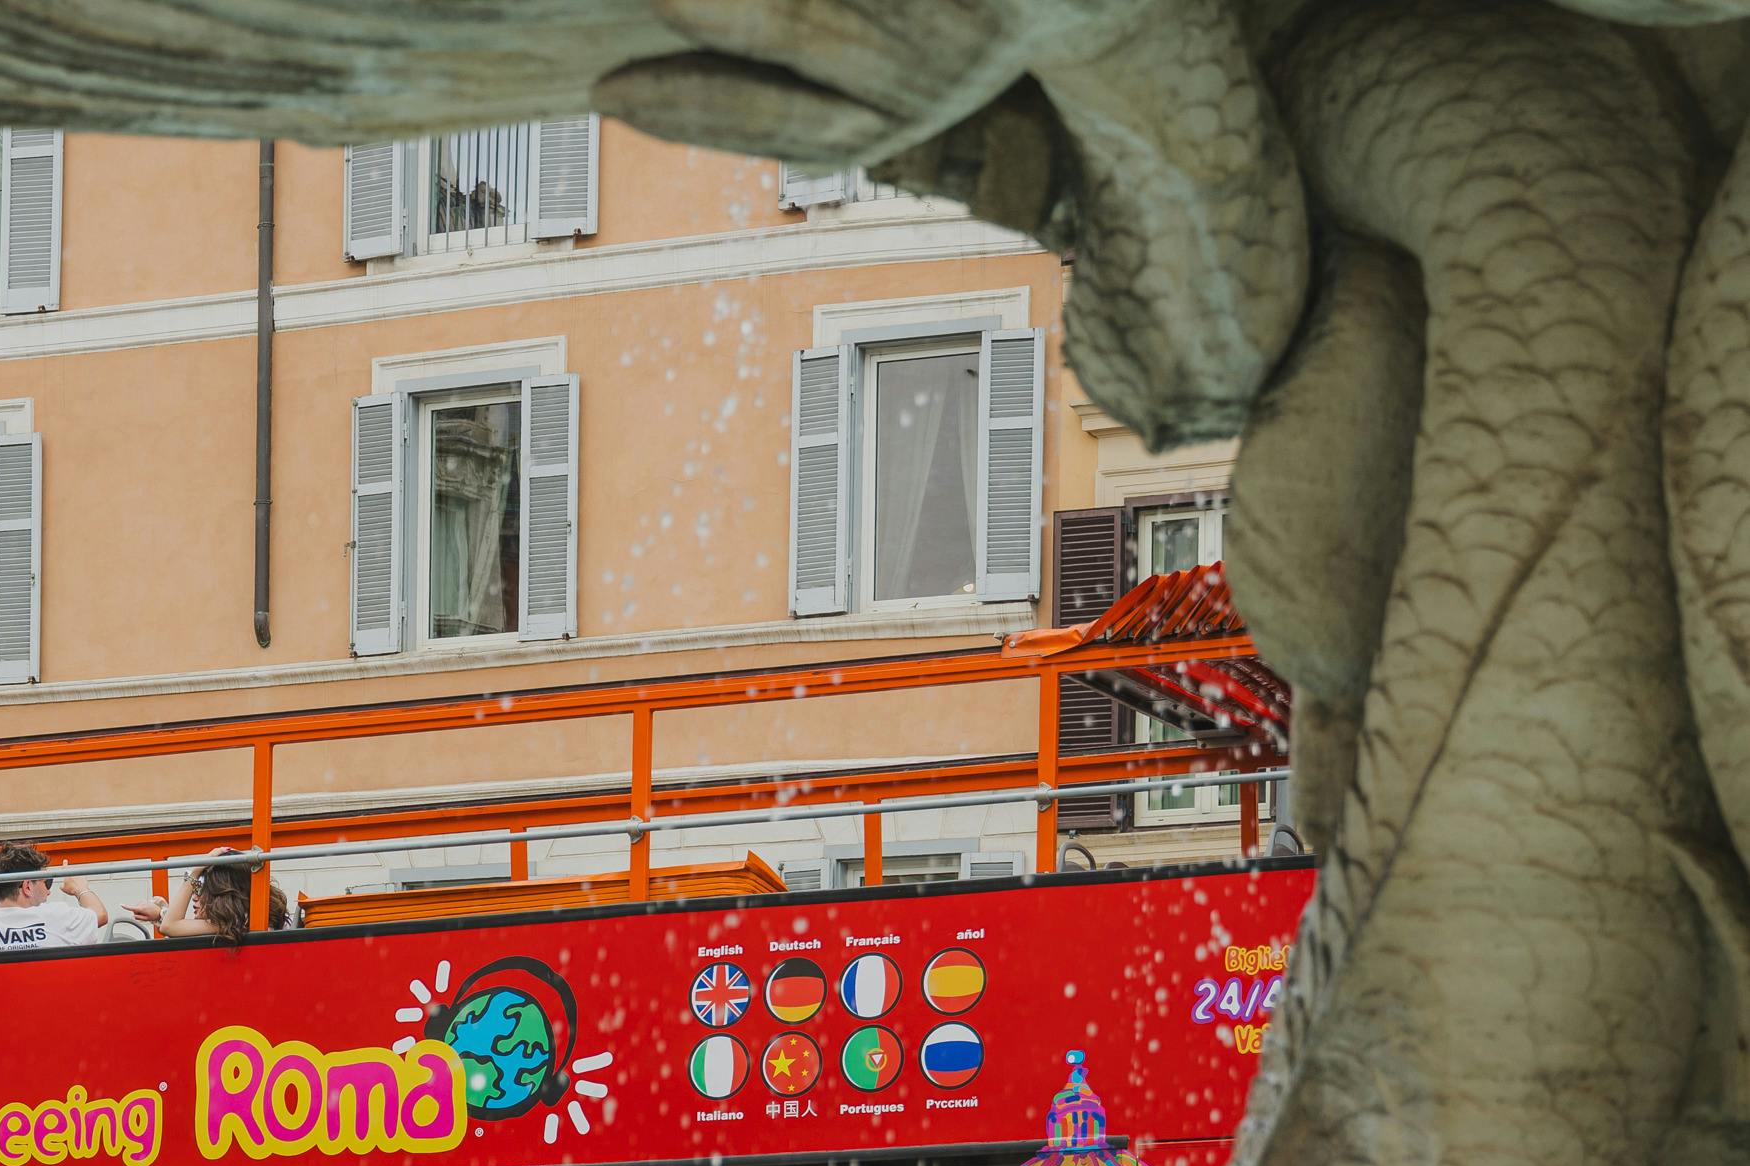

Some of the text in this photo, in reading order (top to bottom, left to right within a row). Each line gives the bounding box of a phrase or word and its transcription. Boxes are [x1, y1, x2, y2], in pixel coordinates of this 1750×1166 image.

[770, 939, 821, 952] Deutsch
[845, 934, 900, 947] Français
[698, 945, 743, 958] English
[203, 1034, 460, 1151] Roma
[765, 1100, 818, 1119] 中国人
[840, 1103, 904, 1115] Portugues
[697, 1111, 744, 1121] Italiano
